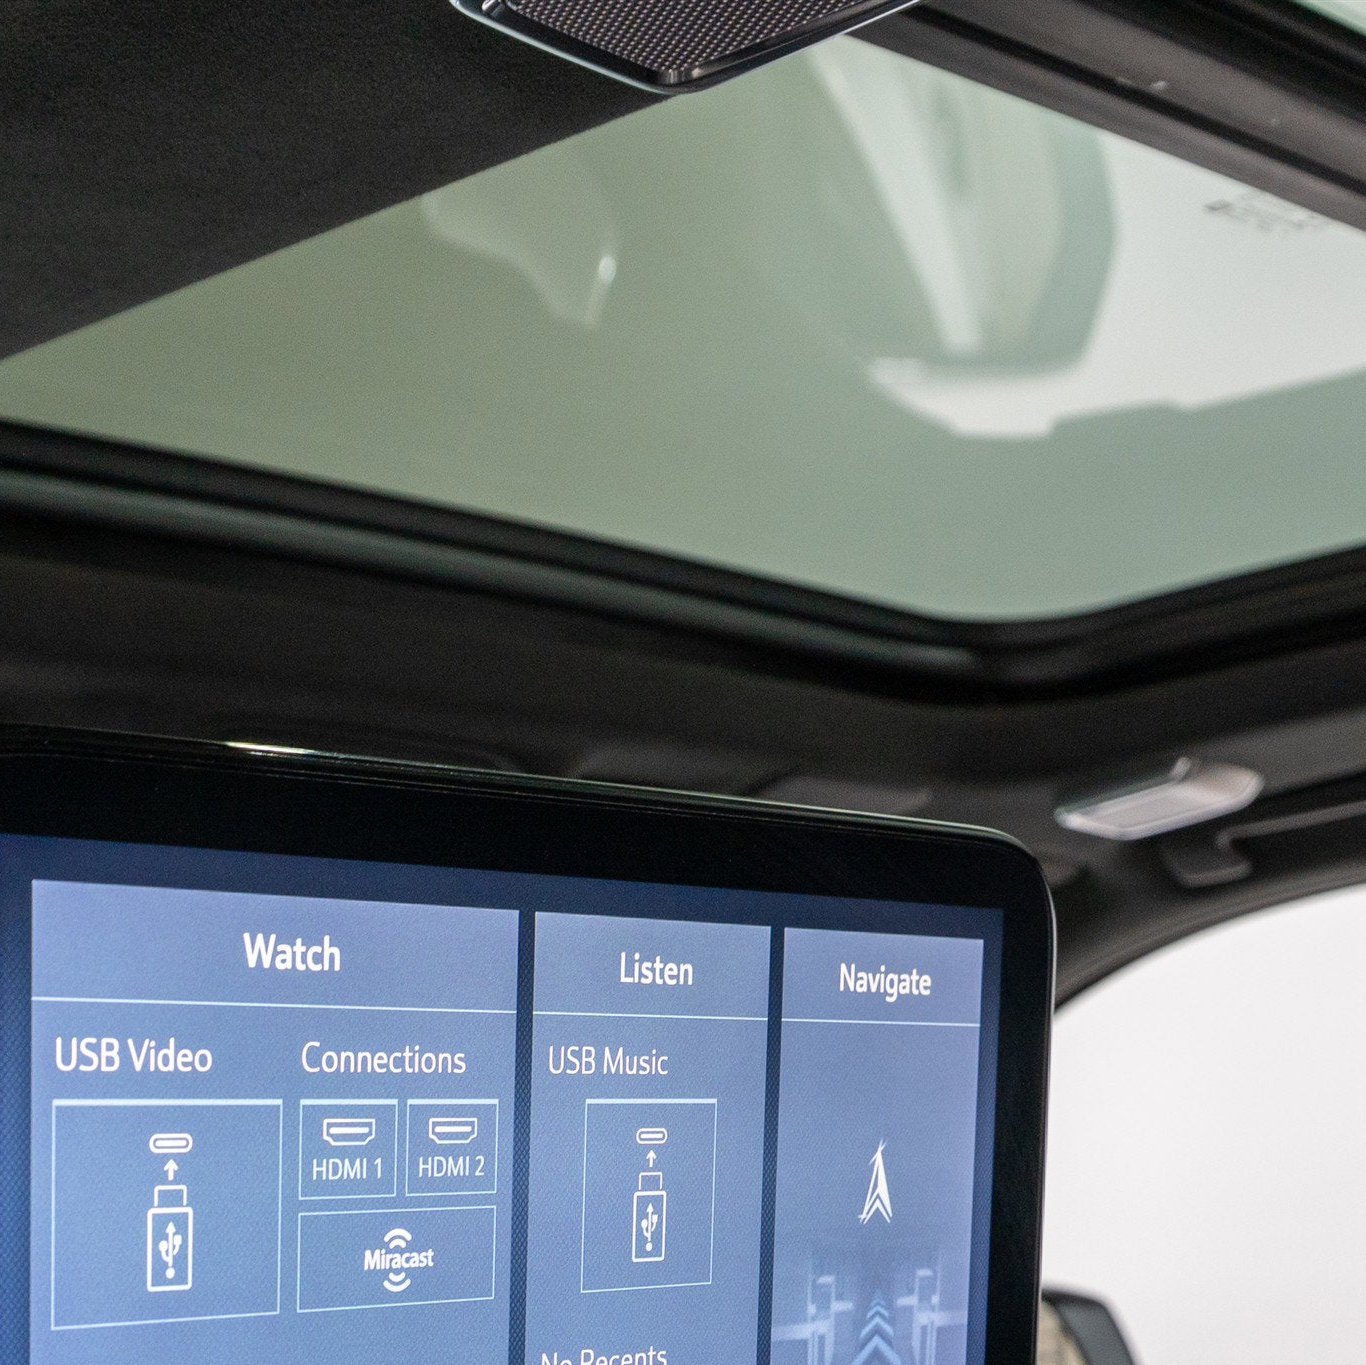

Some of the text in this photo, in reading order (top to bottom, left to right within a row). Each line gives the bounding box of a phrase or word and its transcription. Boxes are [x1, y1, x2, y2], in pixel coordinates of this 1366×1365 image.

[242, 932, 341, 972] Watch
[620, 951, 693, 986] Listen
[839, 962, 933, 1002] Navigate
[55, 1036, 213, 1073] USB Video
[301, 1041, 467, 1074] Connections
[548, 1045, 669, 1075] USB Music
[312, 1157, 382, 1181] HDMI 1
[418, 1155, 485, 1178] HDMI 2
[364, 1245, 436, 1271] Miracast
